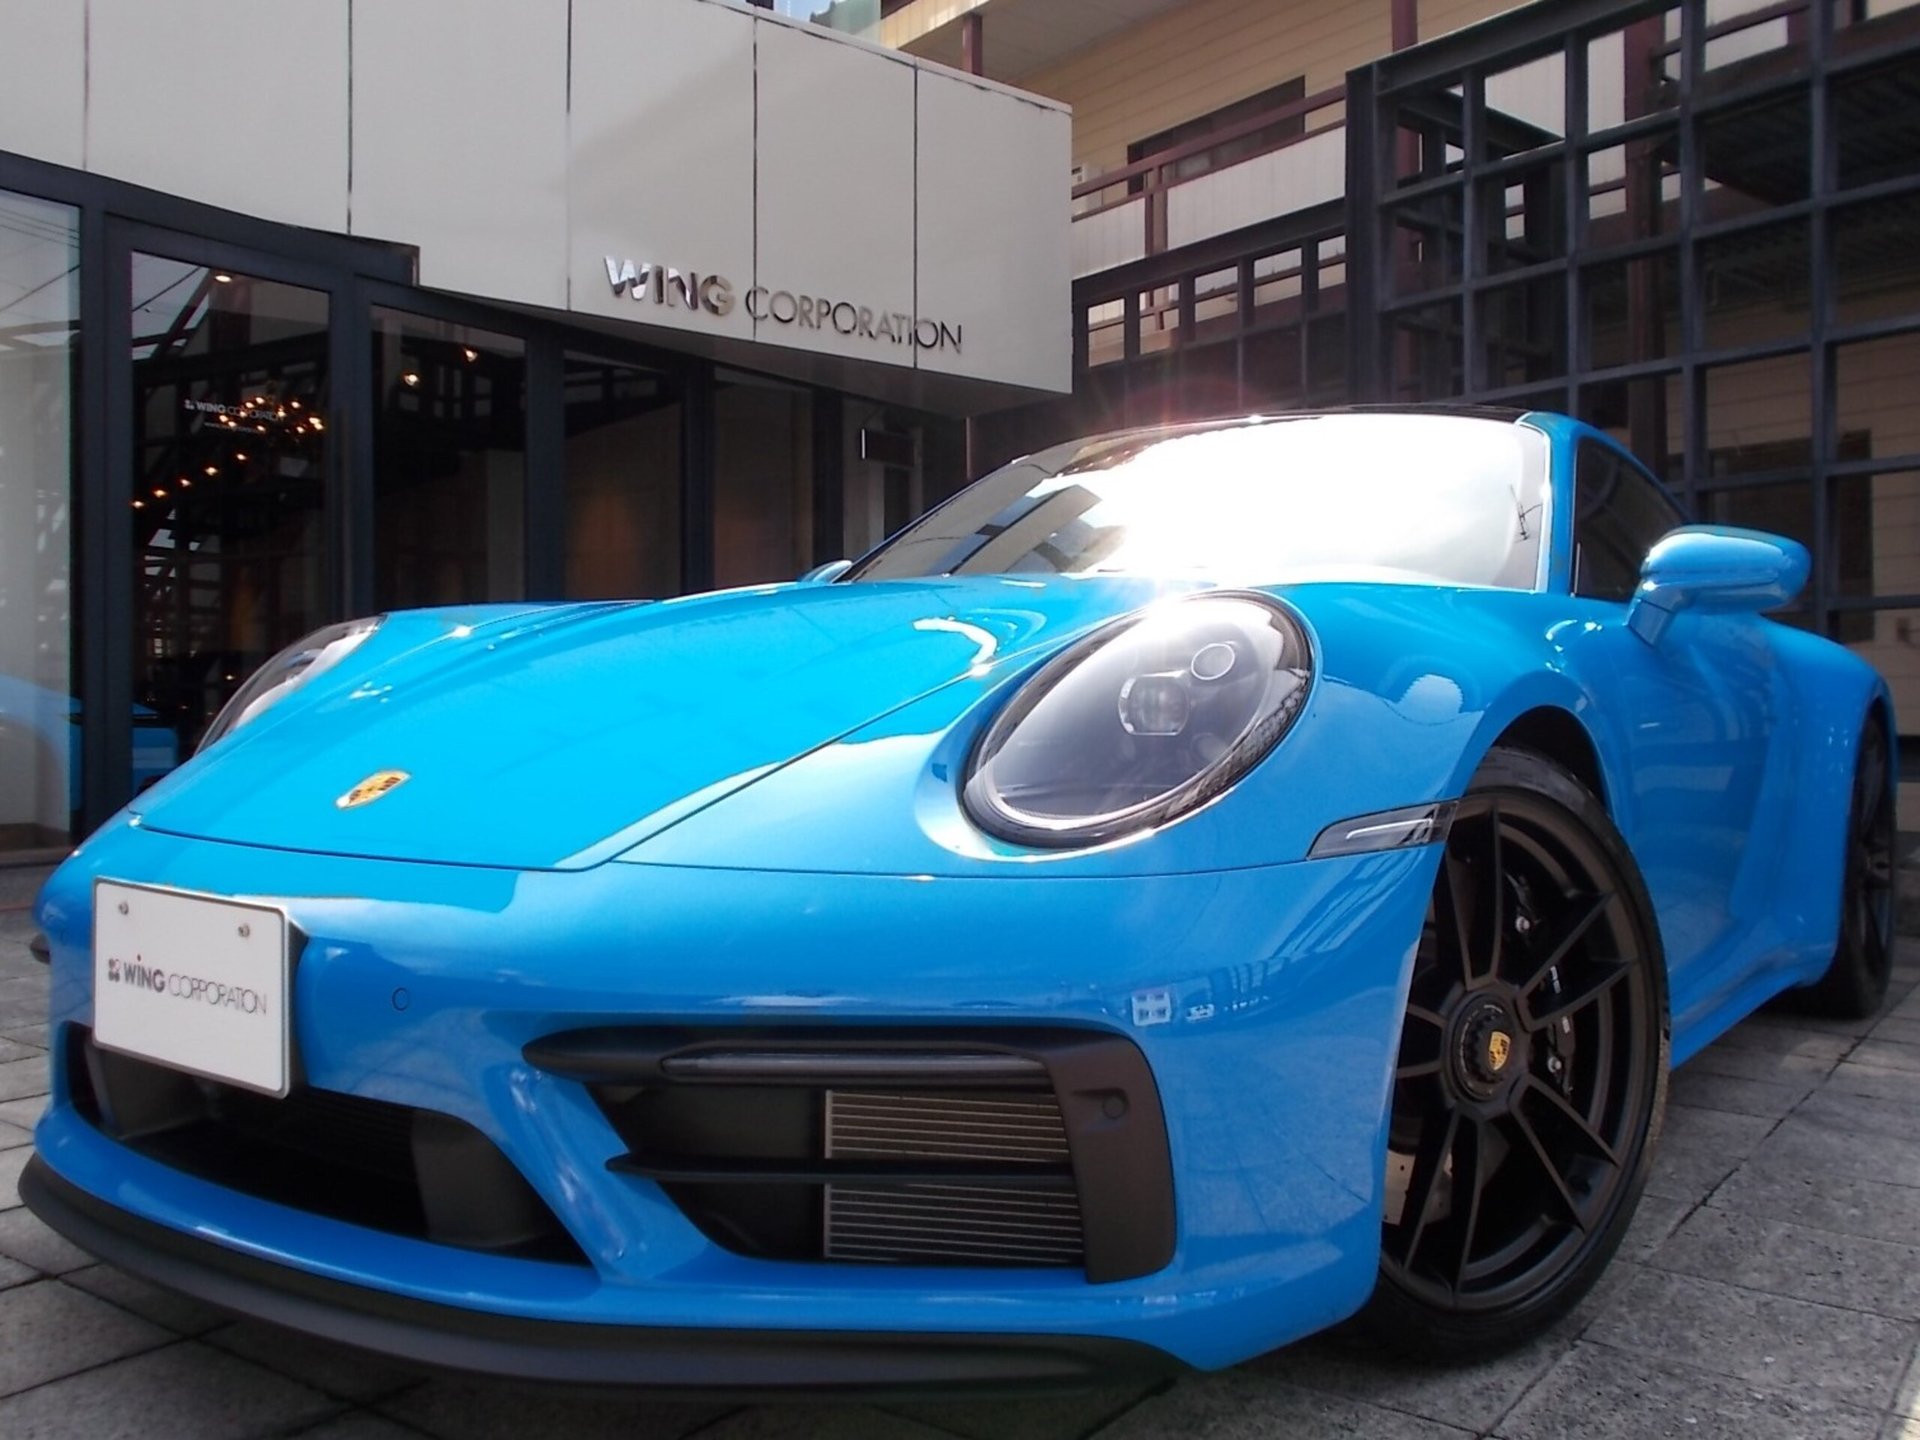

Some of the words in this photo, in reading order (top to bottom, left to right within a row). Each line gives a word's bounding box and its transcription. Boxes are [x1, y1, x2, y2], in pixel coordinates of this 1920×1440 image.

[604, 254, 735, 317] WING
[745, 285, 963, 354] CORPORATION
[168, 973, 267, 1014] CORPORATION
